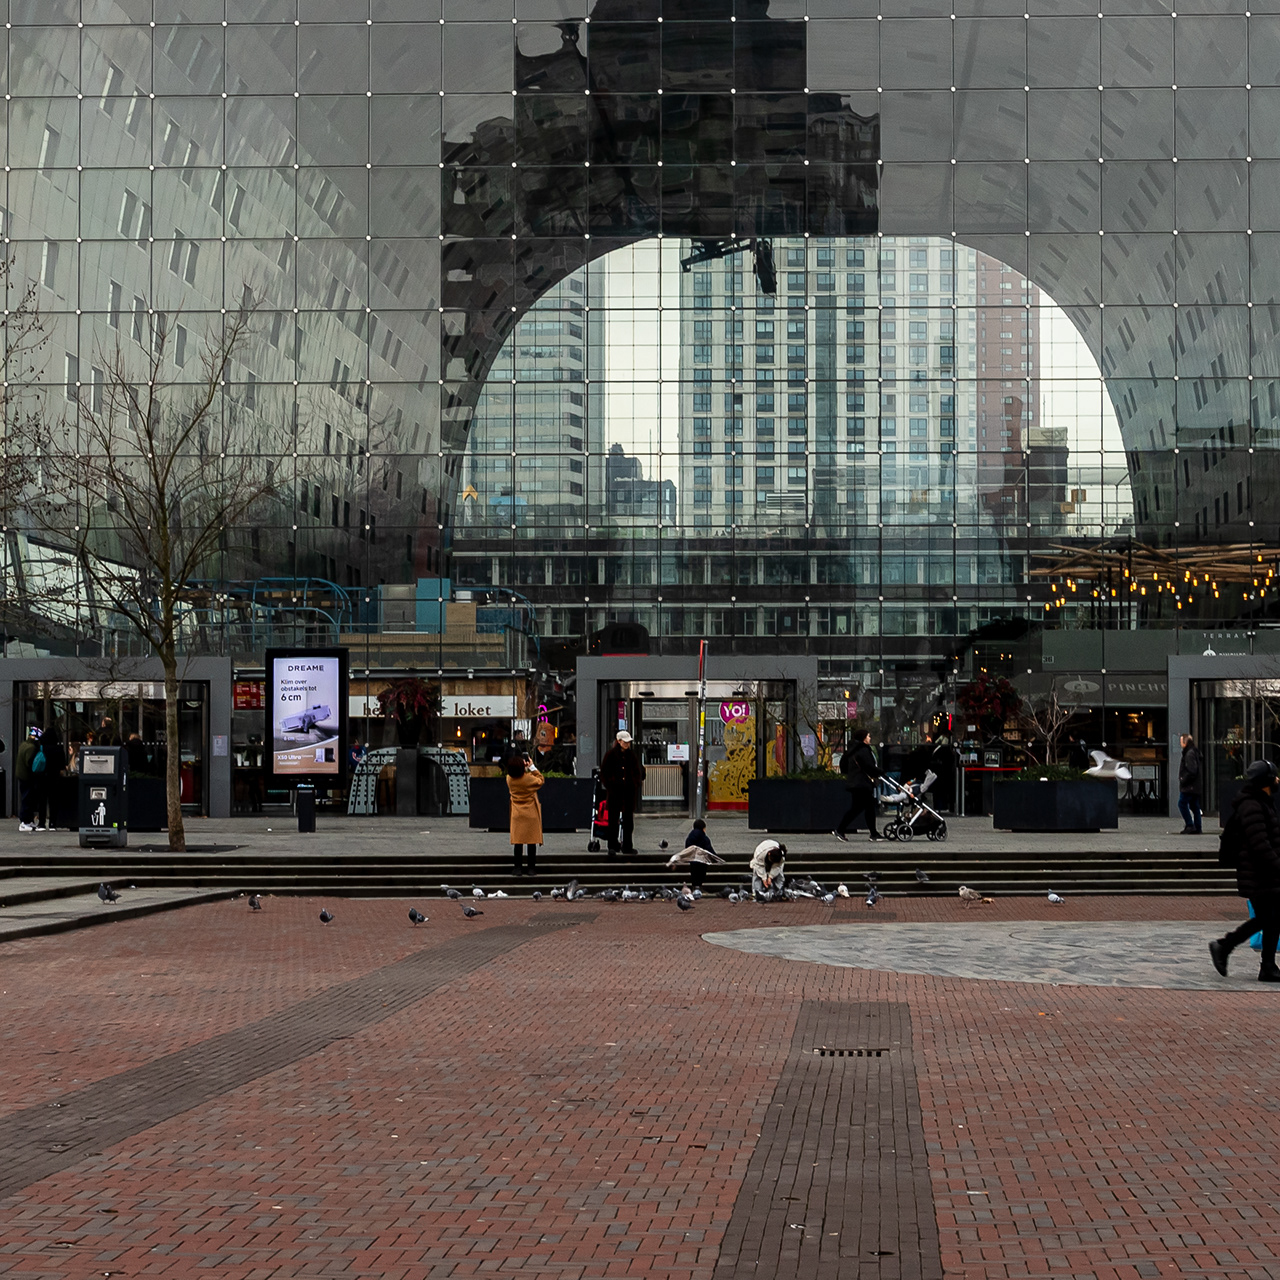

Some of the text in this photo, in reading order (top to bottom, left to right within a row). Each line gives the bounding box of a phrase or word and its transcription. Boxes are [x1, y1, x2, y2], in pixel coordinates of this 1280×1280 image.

[280, 693, 287, 701] 6
[454, 702, 491, 716] loket
[723, 704, 746, 717] YO!
